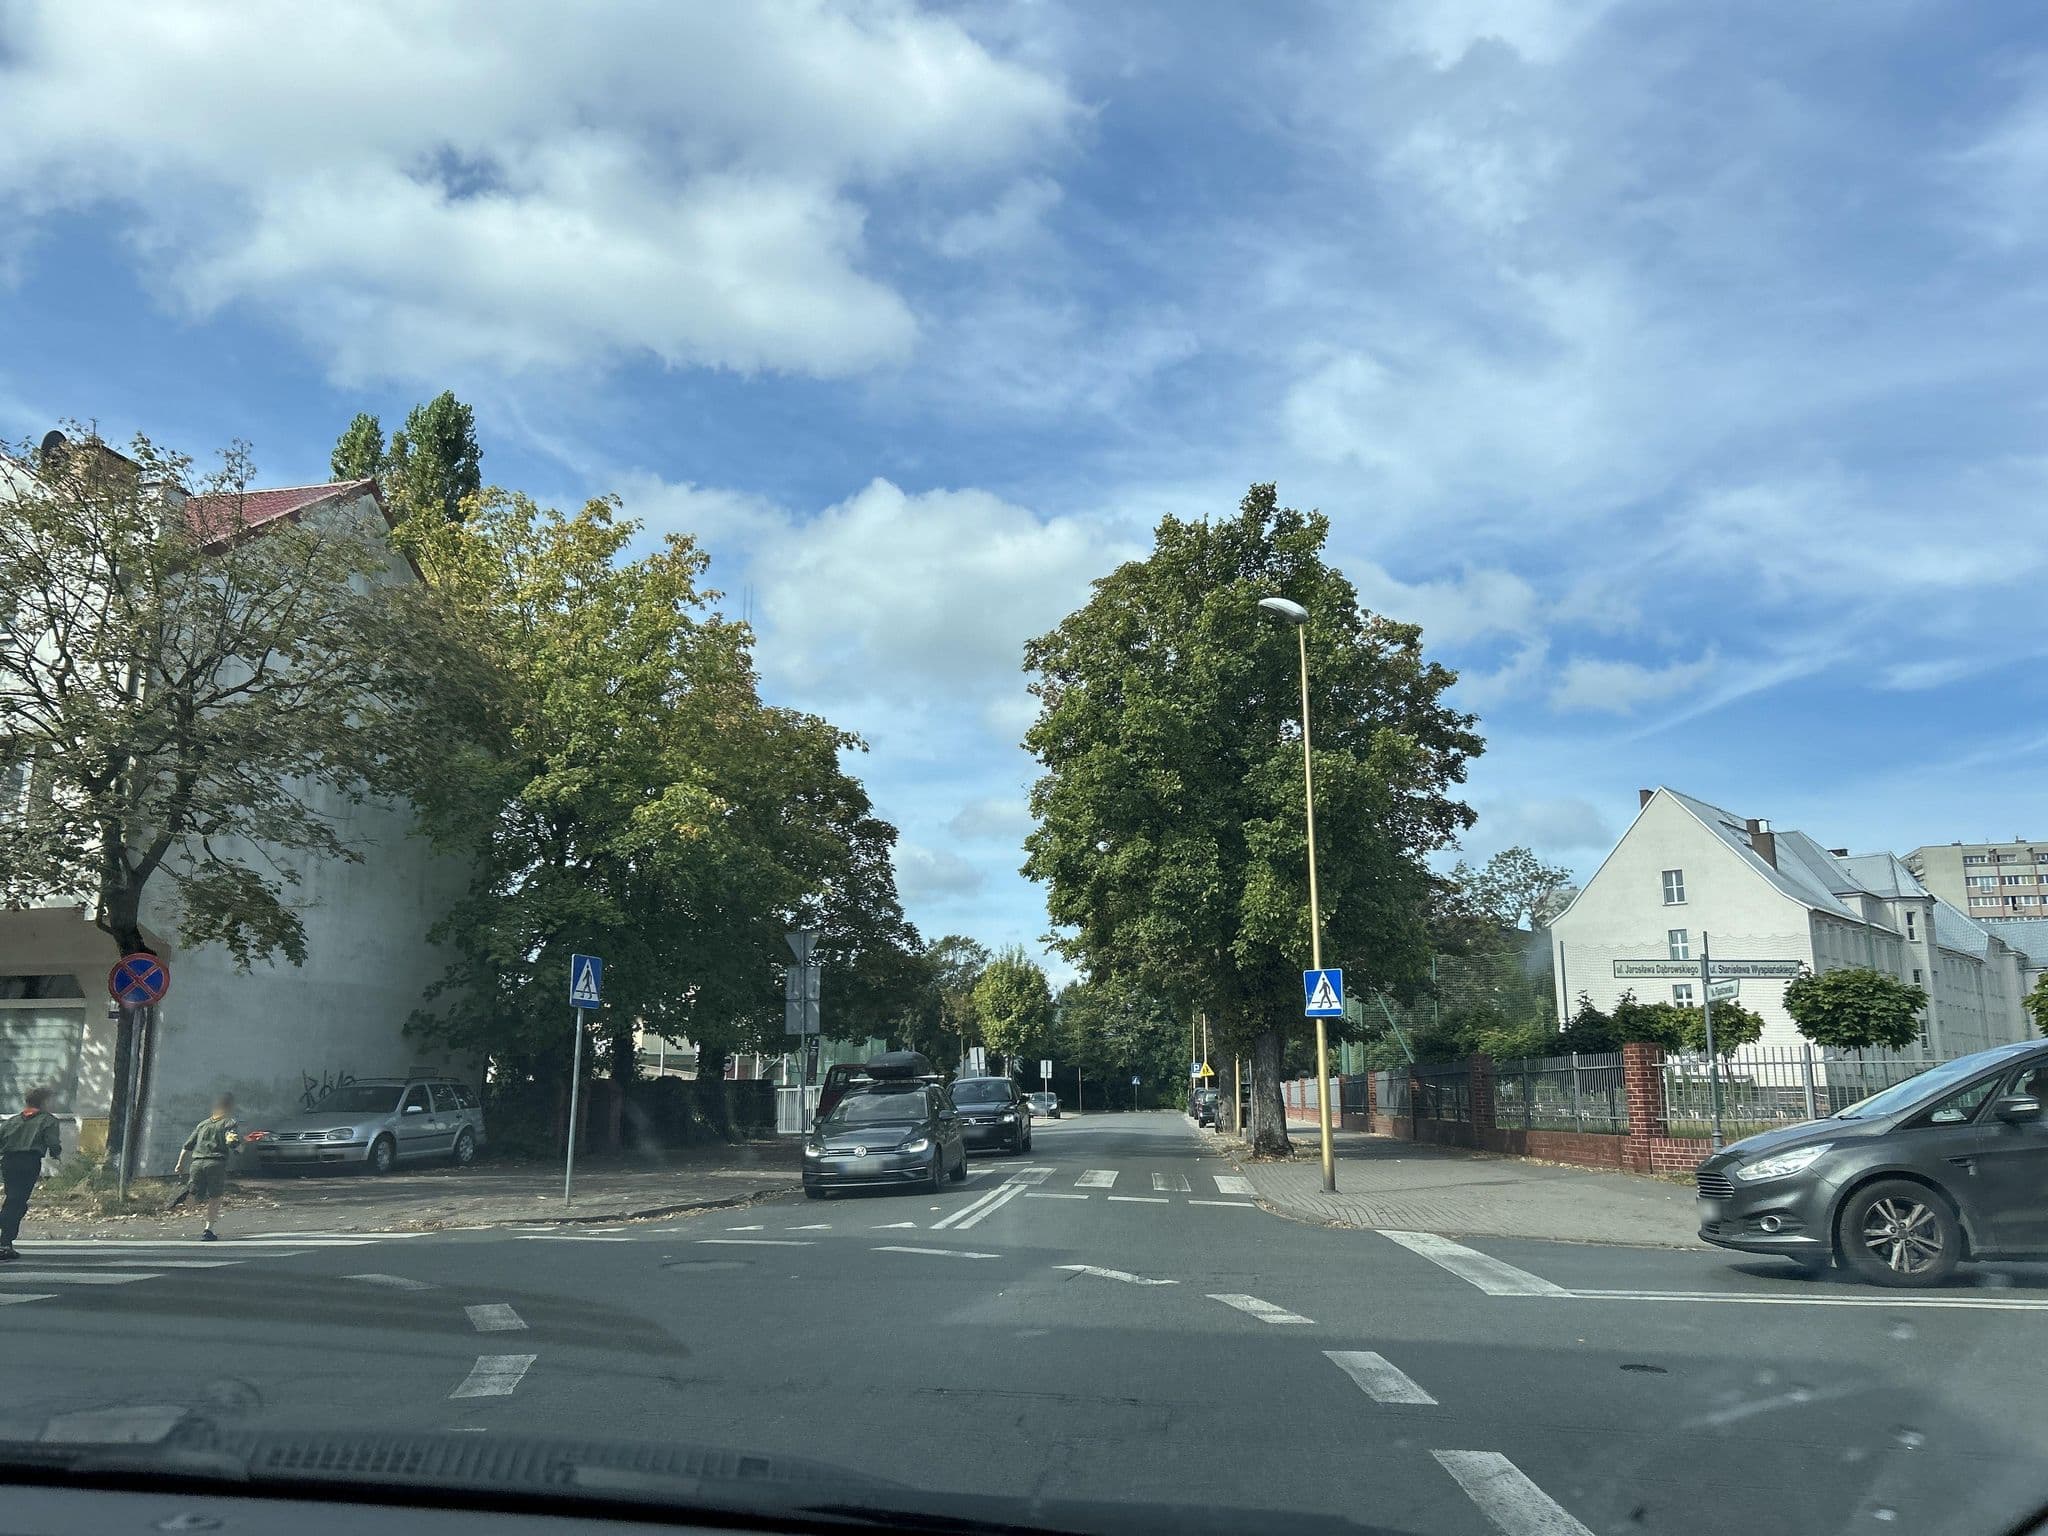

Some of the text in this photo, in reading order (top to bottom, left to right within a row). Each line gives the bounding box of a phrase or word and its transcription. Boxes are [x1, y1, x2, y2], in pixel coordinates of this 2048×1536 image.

[1625, 964, 1655, 974] Jarosława
[1656, 964, 1699, 976] Dąbrowskiego
[1718, 964, 1750, 974] Stanisława
